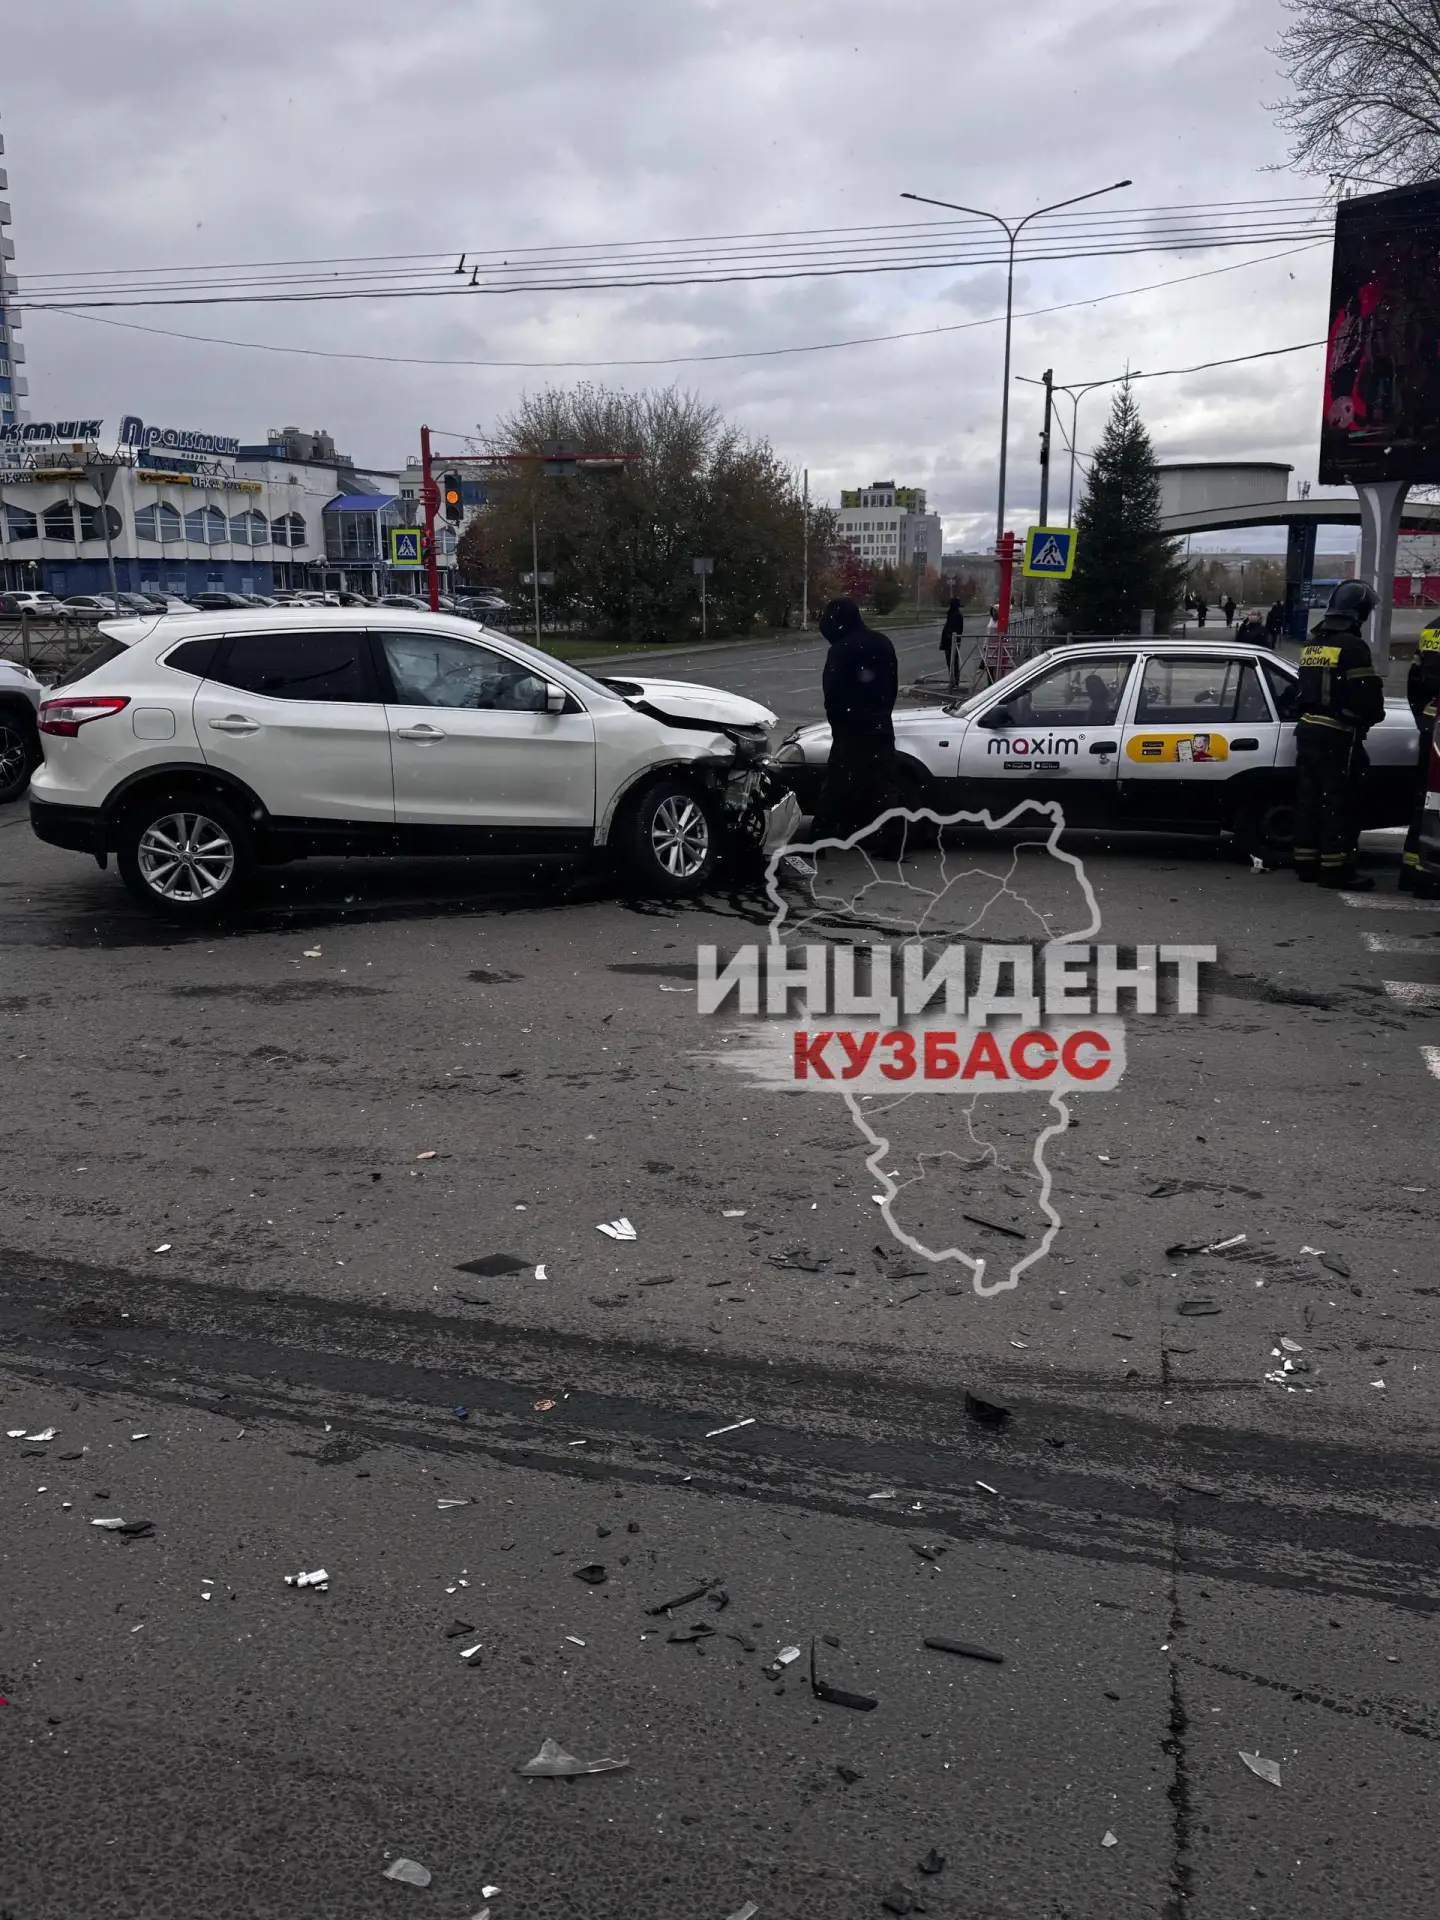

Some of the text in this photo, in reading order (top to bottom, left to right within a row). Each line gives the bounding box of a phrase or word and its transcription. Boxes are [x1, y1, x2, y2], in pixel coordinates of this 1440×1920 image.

[119, 415, 241, 454] Практик
[1305, 646, 1323, 656] МЧС
[987, 732, 1079, 755] maxim
